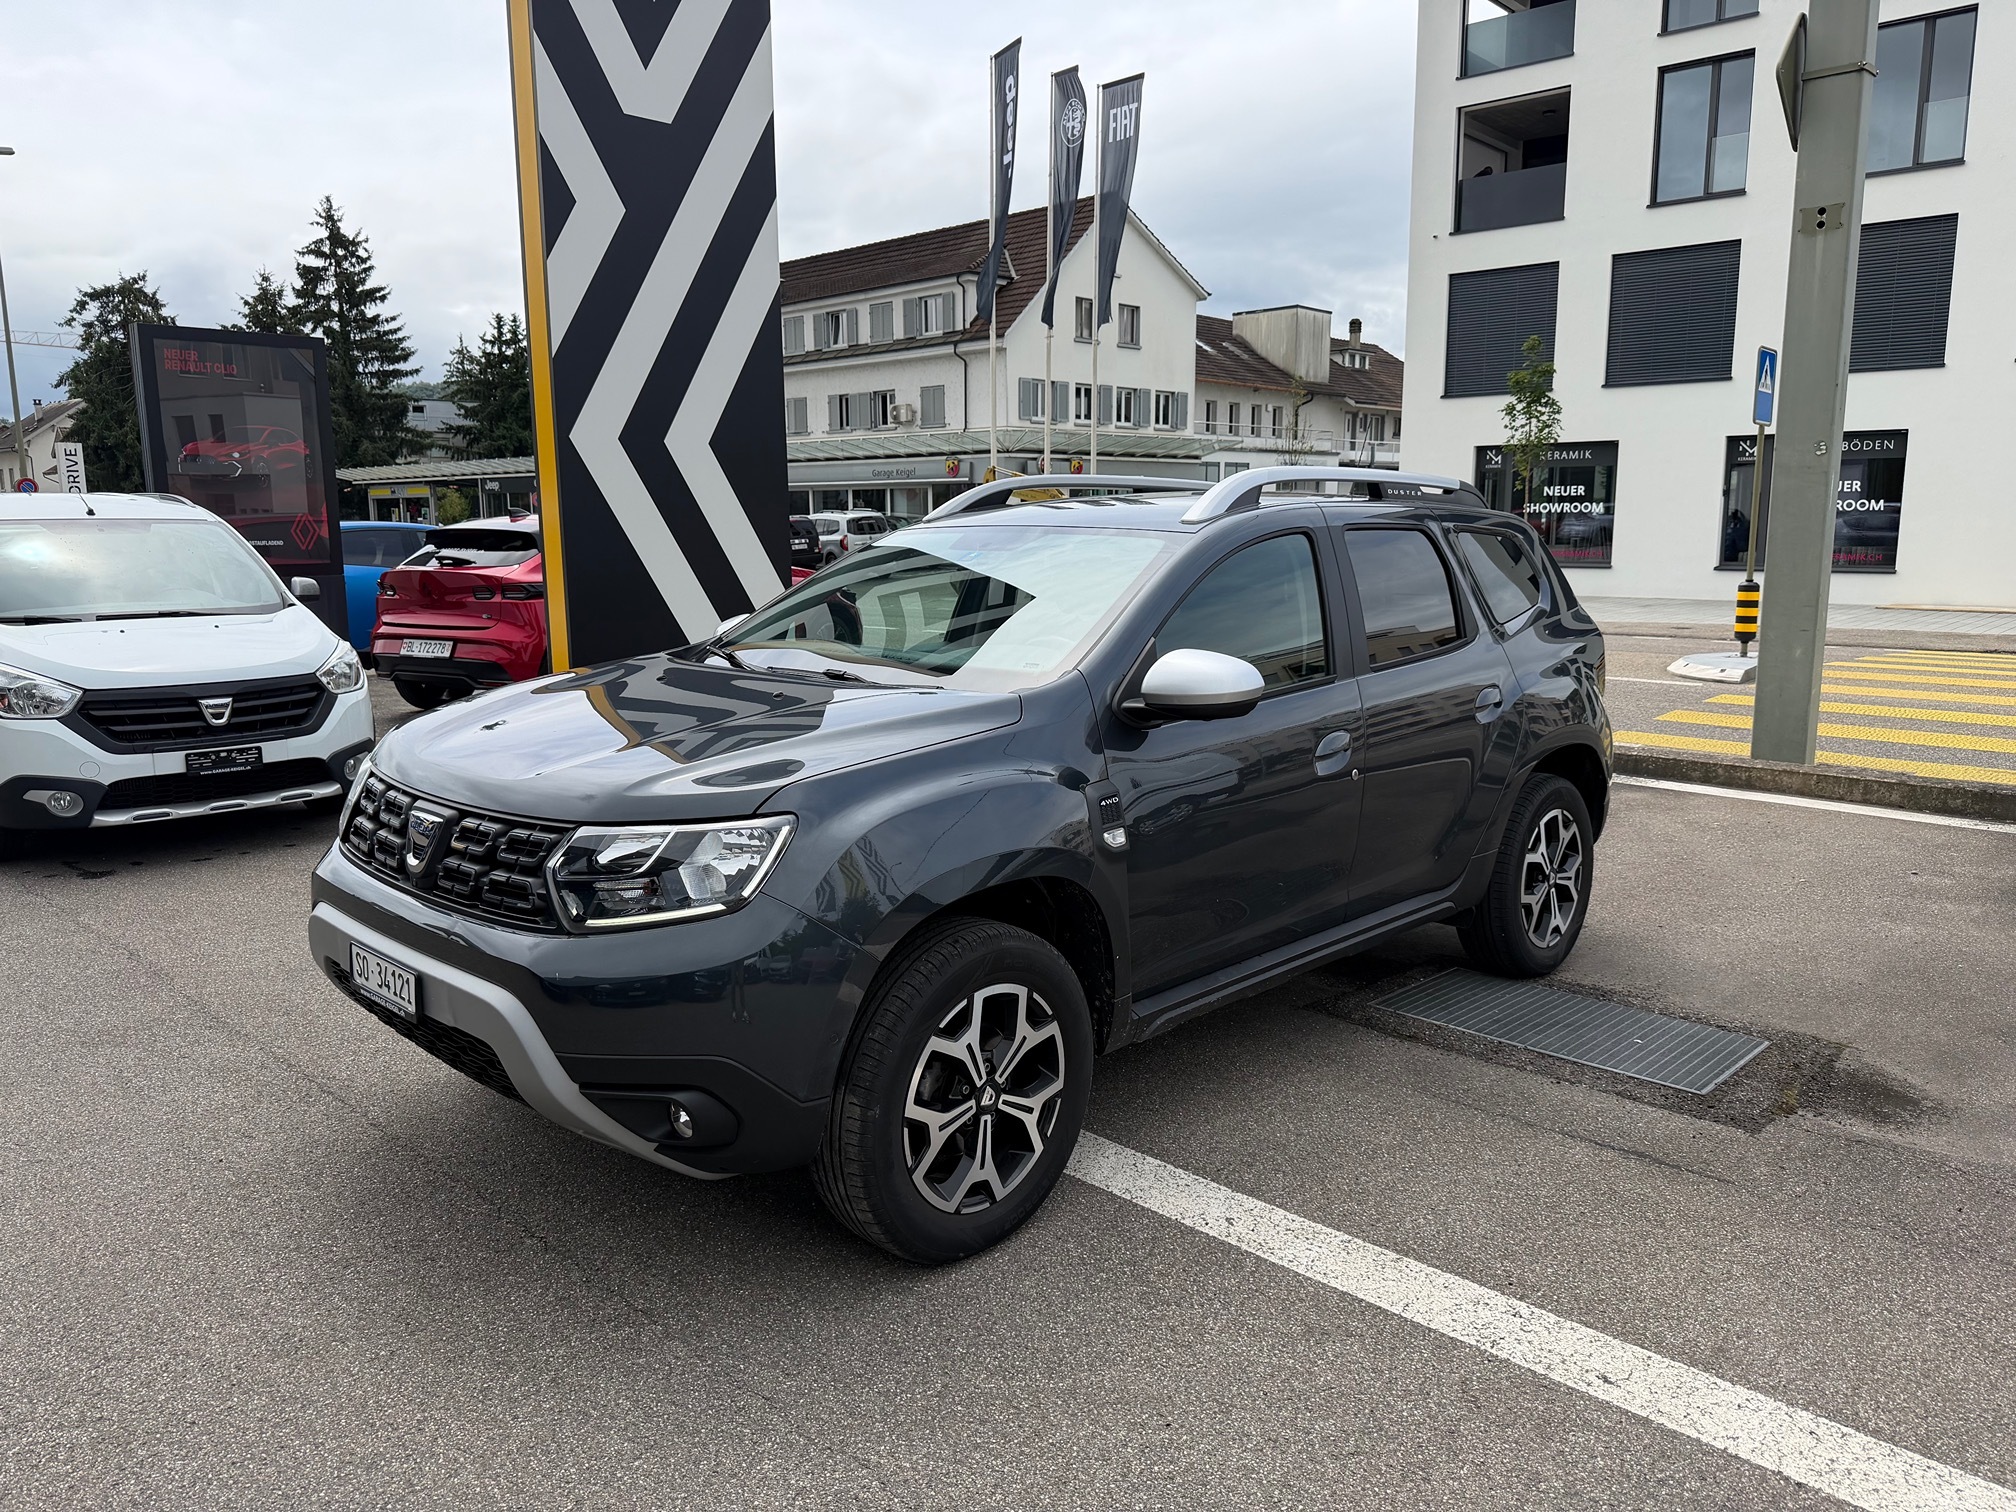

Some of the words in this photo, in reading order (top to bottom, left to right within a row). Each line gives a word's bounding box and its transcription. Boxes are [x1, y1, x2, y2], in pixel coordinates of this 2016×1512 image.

[1003, 74, 1016, 178] Jeep
[1108, 102, 1139, 143] FIAT
[163, 348, 199, 361] NEUER
[164, 359, 212, 374] RENAULT
[213, 363, 237, 375] CLIO
[1842, 438, 1894, 450] BÖDEN
[1540, 449, 1592, 460] KERAMIK
[871, 469, 895, 479] Garage
[895, 467, 916, 479] Keigel
[484, 479, 500, 491] Jeep
[1543, 485, 1586, 497] NEUER
[1387, 488, 1422, 496] DUSTER
[1522, 501, 1605, 514] SHOWROOM
[1100, 796, 1119, 806] 4WD
